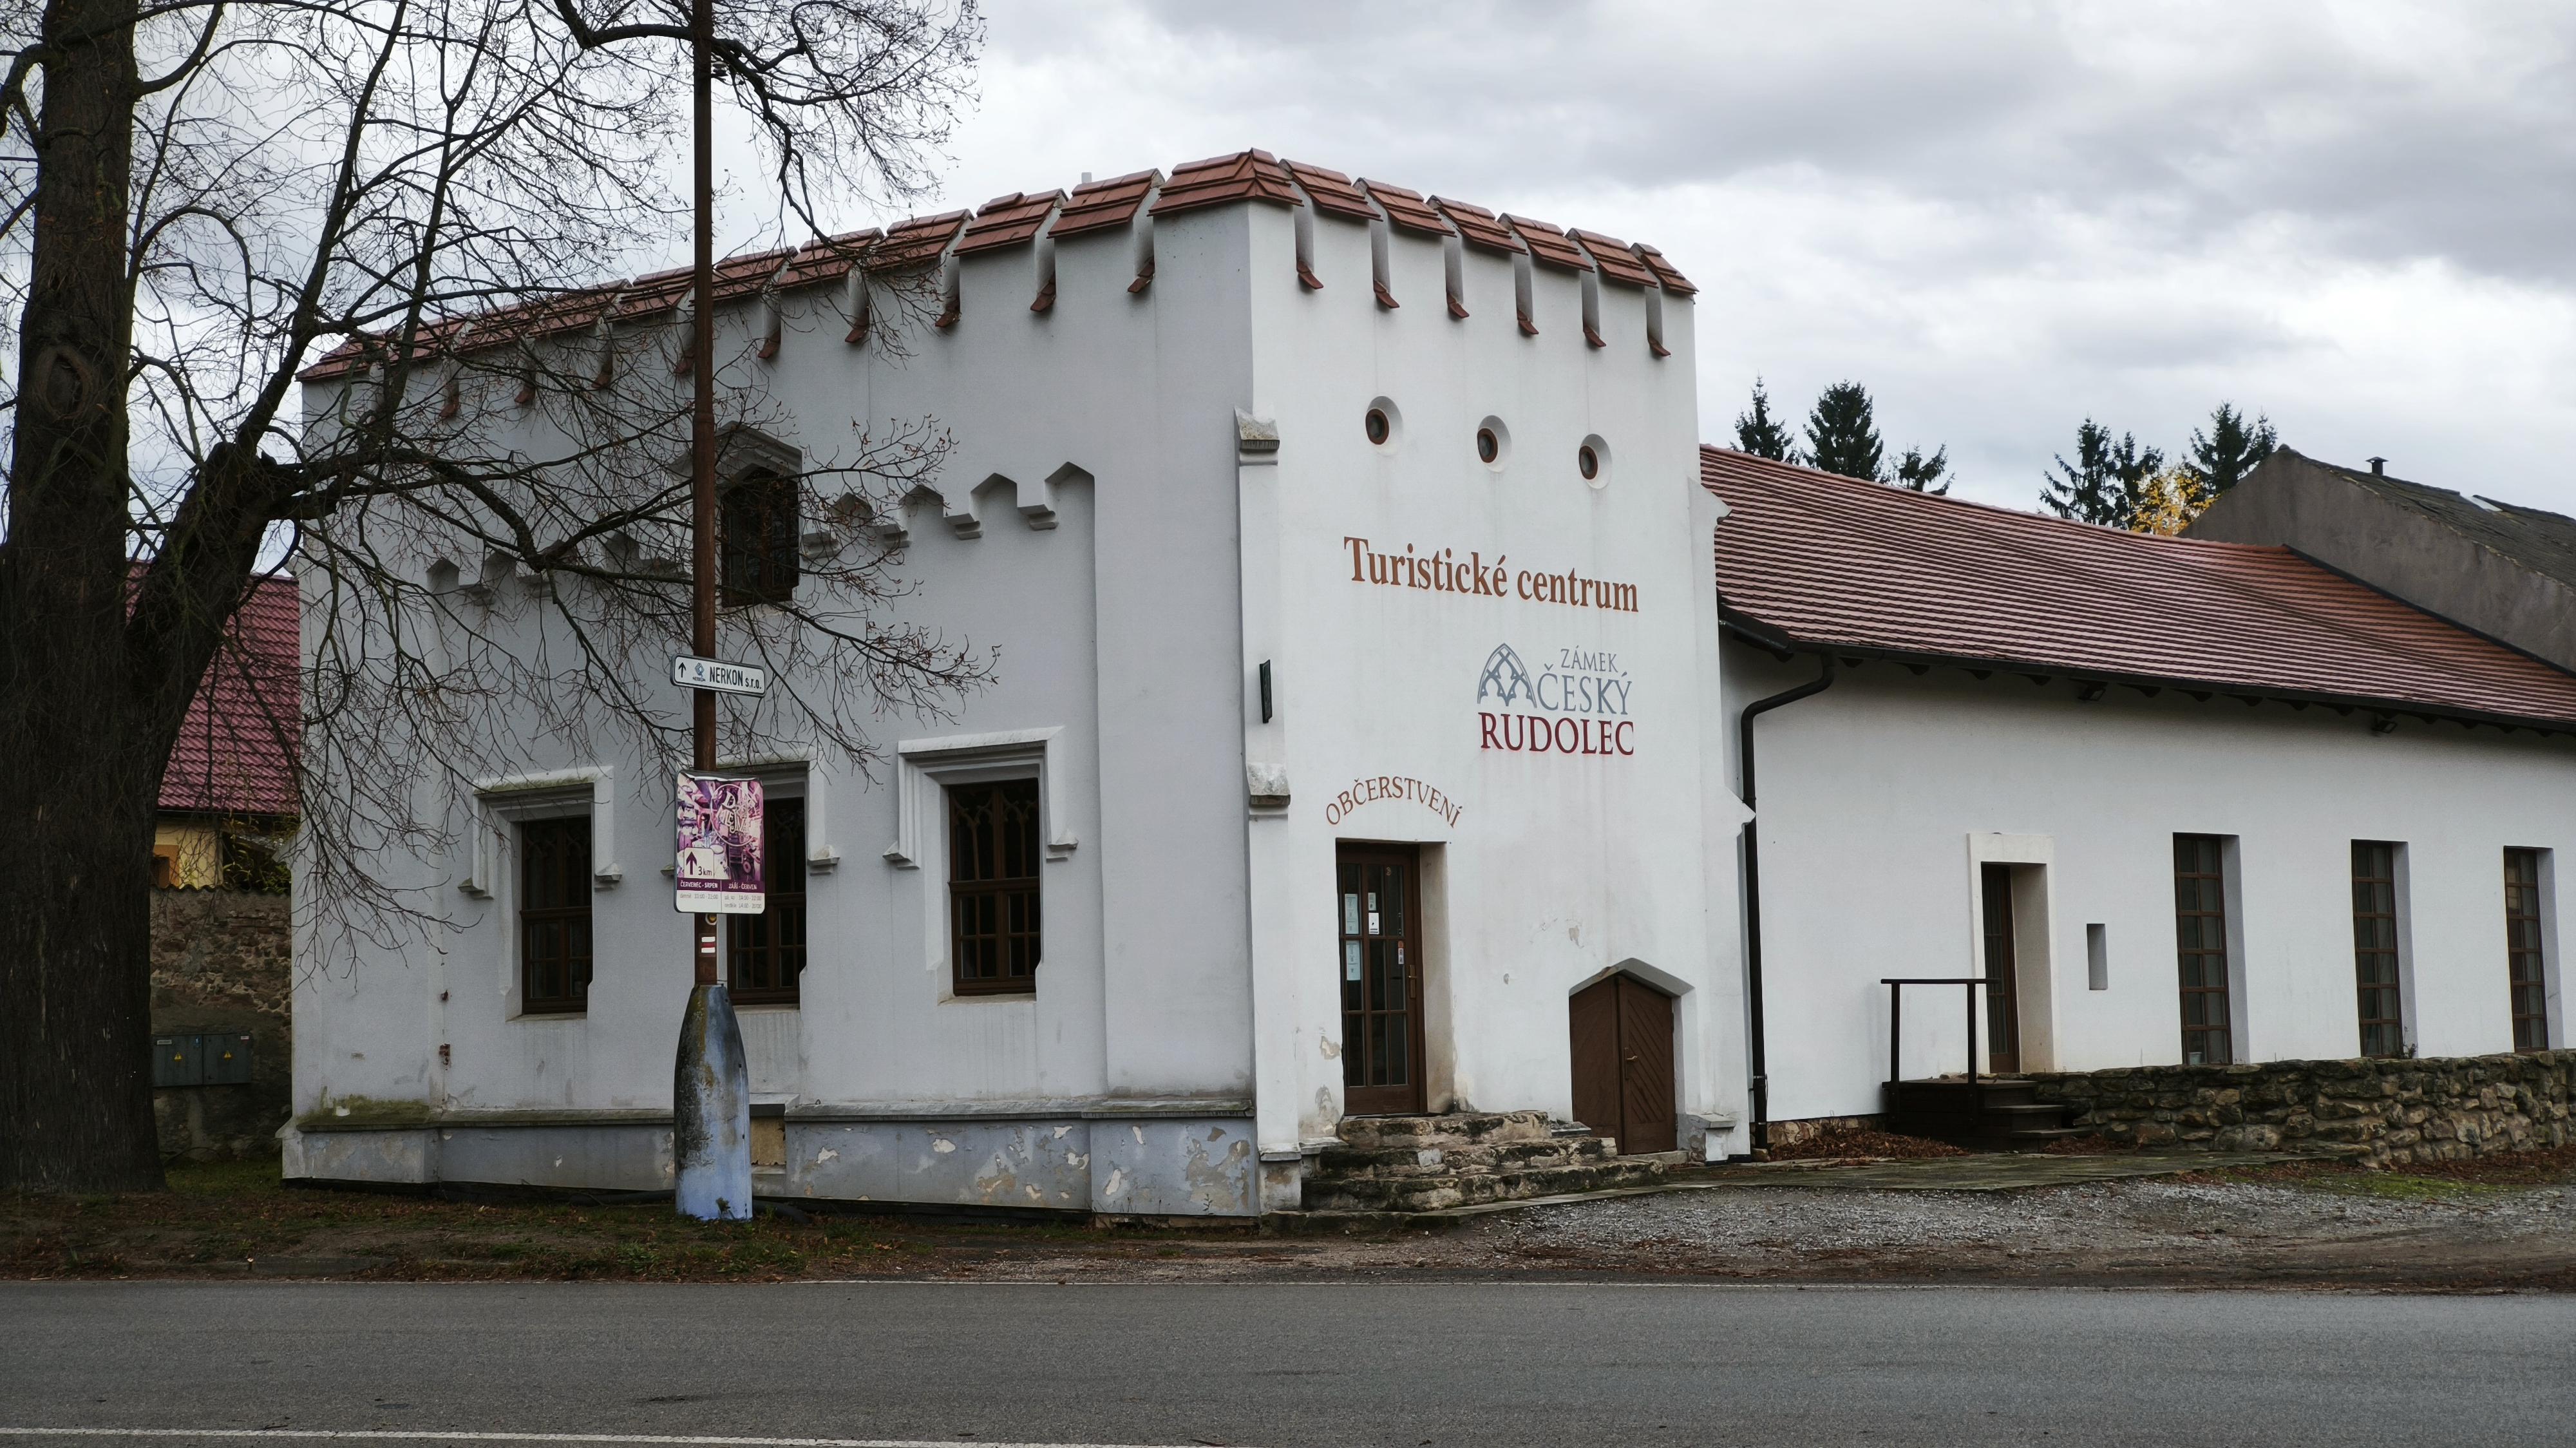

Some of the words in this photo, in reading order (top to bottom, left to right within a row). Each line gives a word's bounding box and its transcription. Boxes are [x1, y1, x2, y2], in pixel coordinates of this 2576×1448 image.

[1343, 536, 1508, 598] Turistické
[1517, 567, 1639, 613] centrum
[709, 666, 744, 687] NERKON
[744, 678, 762, 689] s.r.o.
[1560, 645, 1619, 673] ZÁMEK
[1537, 663, 1633, 716] ČESKÝ
[1477, 712, 1634, 756] RUDOLEC
[1326, 776, 1463, 829] OBČERSTVENÍ
